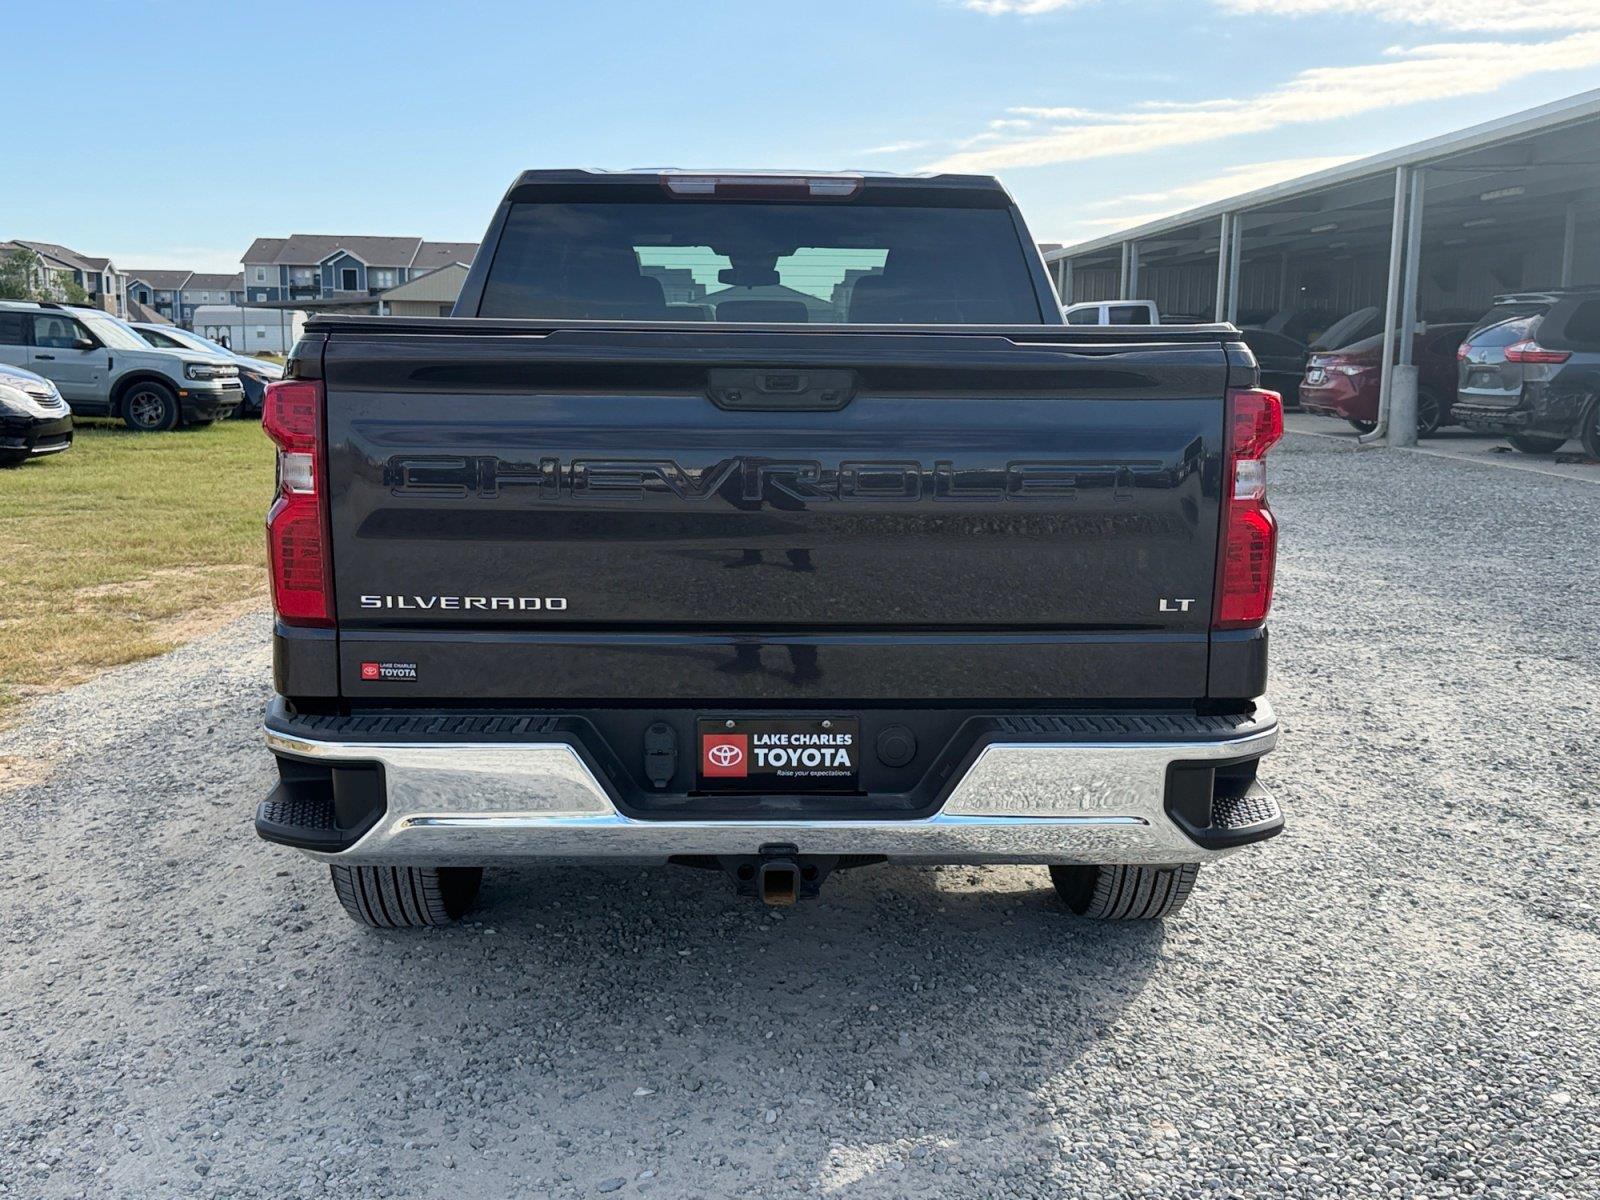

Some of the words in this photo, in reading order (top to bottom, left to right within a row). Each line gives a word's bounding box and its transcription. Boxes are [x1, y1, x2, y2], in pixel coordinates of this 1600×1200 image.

[390, 455, 1165, 501] CHEVROLET
[360, 595, 568, 610] SILVERADO
[1159, 598, 1196, 612] LT
[380, 669, 416, 677] TOYOTA
[753, 734, 789, 745] LAKE
[791, 734, 852, 745] CHARLES
[754, 748, 851, 767] TOYOTA
